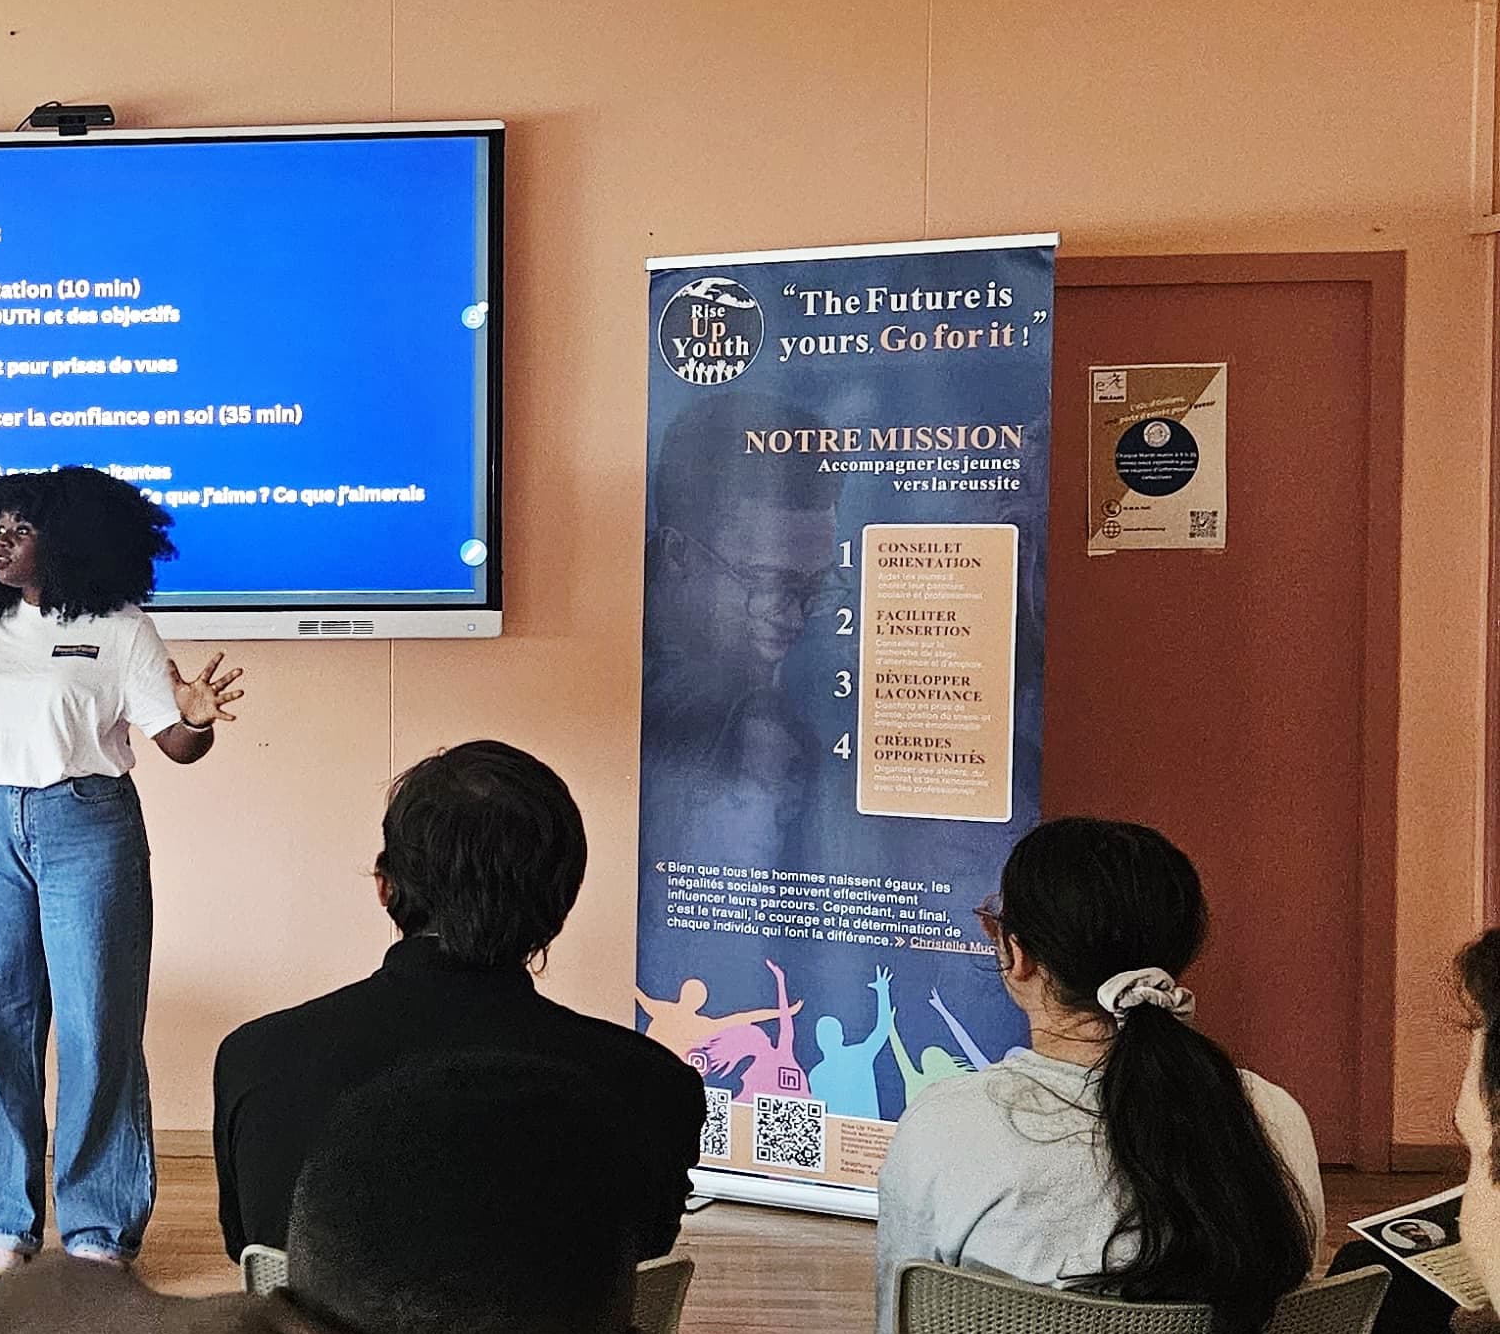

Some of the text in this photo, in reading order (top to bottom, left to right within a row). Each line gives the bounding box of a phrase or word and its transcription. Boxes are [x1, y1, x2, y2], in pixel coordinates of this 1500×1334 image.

[57, 279, 90, 299] (10
[94, 277, 141, 299] min)
[866, 287, 982, 313] Future
[987, 281, 1013, 307] is
[44, 308, 64, 325] et
[66, 306, 98, 325] des
[101, 305, 180, 327] objectifs
[691, 304, 726, 319] Rise
[692, 317, 727, 339] Up
[880, 325, 927, 353] Go
[932, 322, 983, 350] for
[988, 321, 1015, 347] it
[672, 336, 750, 359] Youth
[7, 360, 50, 379] pour
[52, 357, 106, 379] prises
[109, 357, 132, 374] de
[135, 358, 178, 373] vues
[27, 407, 46, 427] la
[50, 406, 150, 427] confiance
[154, 411, 180, 426] en
[184, 405, 214, 426] soi
[218, 405, 252, 426] (35
[256, 403, 302, 426] min)
[745, 424, 1024, 454] NOTRE MISSION
[818, 456, 1020, 473] Accompagner les jeunes
[894, 476, 1020, 491] vers la reussite
[166, 489, 200, 507] que
[203, 487, 257, 507] j'aime
[273, 486, 298, 503] Ce
[301, 488, 335, 507] que
[338, 483, 426, 506] j'aimerais
[839, 541, 854, 567] 1
[878, 543, 962, 553] CONSEIL ET
[878, 557, 982, 568] ORIENTATION
[836, 609, 854, 635] 2
[877, 611, 956, 621] FACILITER
[876, 623, 972, 636] L'INSERTION
[834, 671, 851, 697] 3
[876, 669, 970, 687] DÉVELOPPER
[876, 689, 982, 702] LA CONFIANCE
[833, 733, 851, 759] 4
[875, 731, 952, 749] CRÉER DES
[874, 749, 986, 764] OPPORTUNITÉS
[668, 861, 695, 873] Bien
[698, 865, 720, 877] que
[723, 867, 748, 878] tous
[751, 868, 768, 880] les
[772, 869, 826, 883] hommes
[829, 874, 881, 887] naissent
[884, 878, 928, 893] égaux,
[932, 881, 951, 893] les
[668, 875, 918, 905] inégalités sociales peuvent effectivement
[668, 889, 950, 924] influencer leurs parcours. Cependant, au final,
[667, 903, 962, 938] c'est le travail, le courage et la détermination de
[667, 917, 710, 931] chaque
[713, 920, 758, 935] individu
[762, 925, 781, 938] qui
[784, 925, 808, 939] font
[812, 929, 824, 940] la
[910, 936, 966, 951] Christelle
